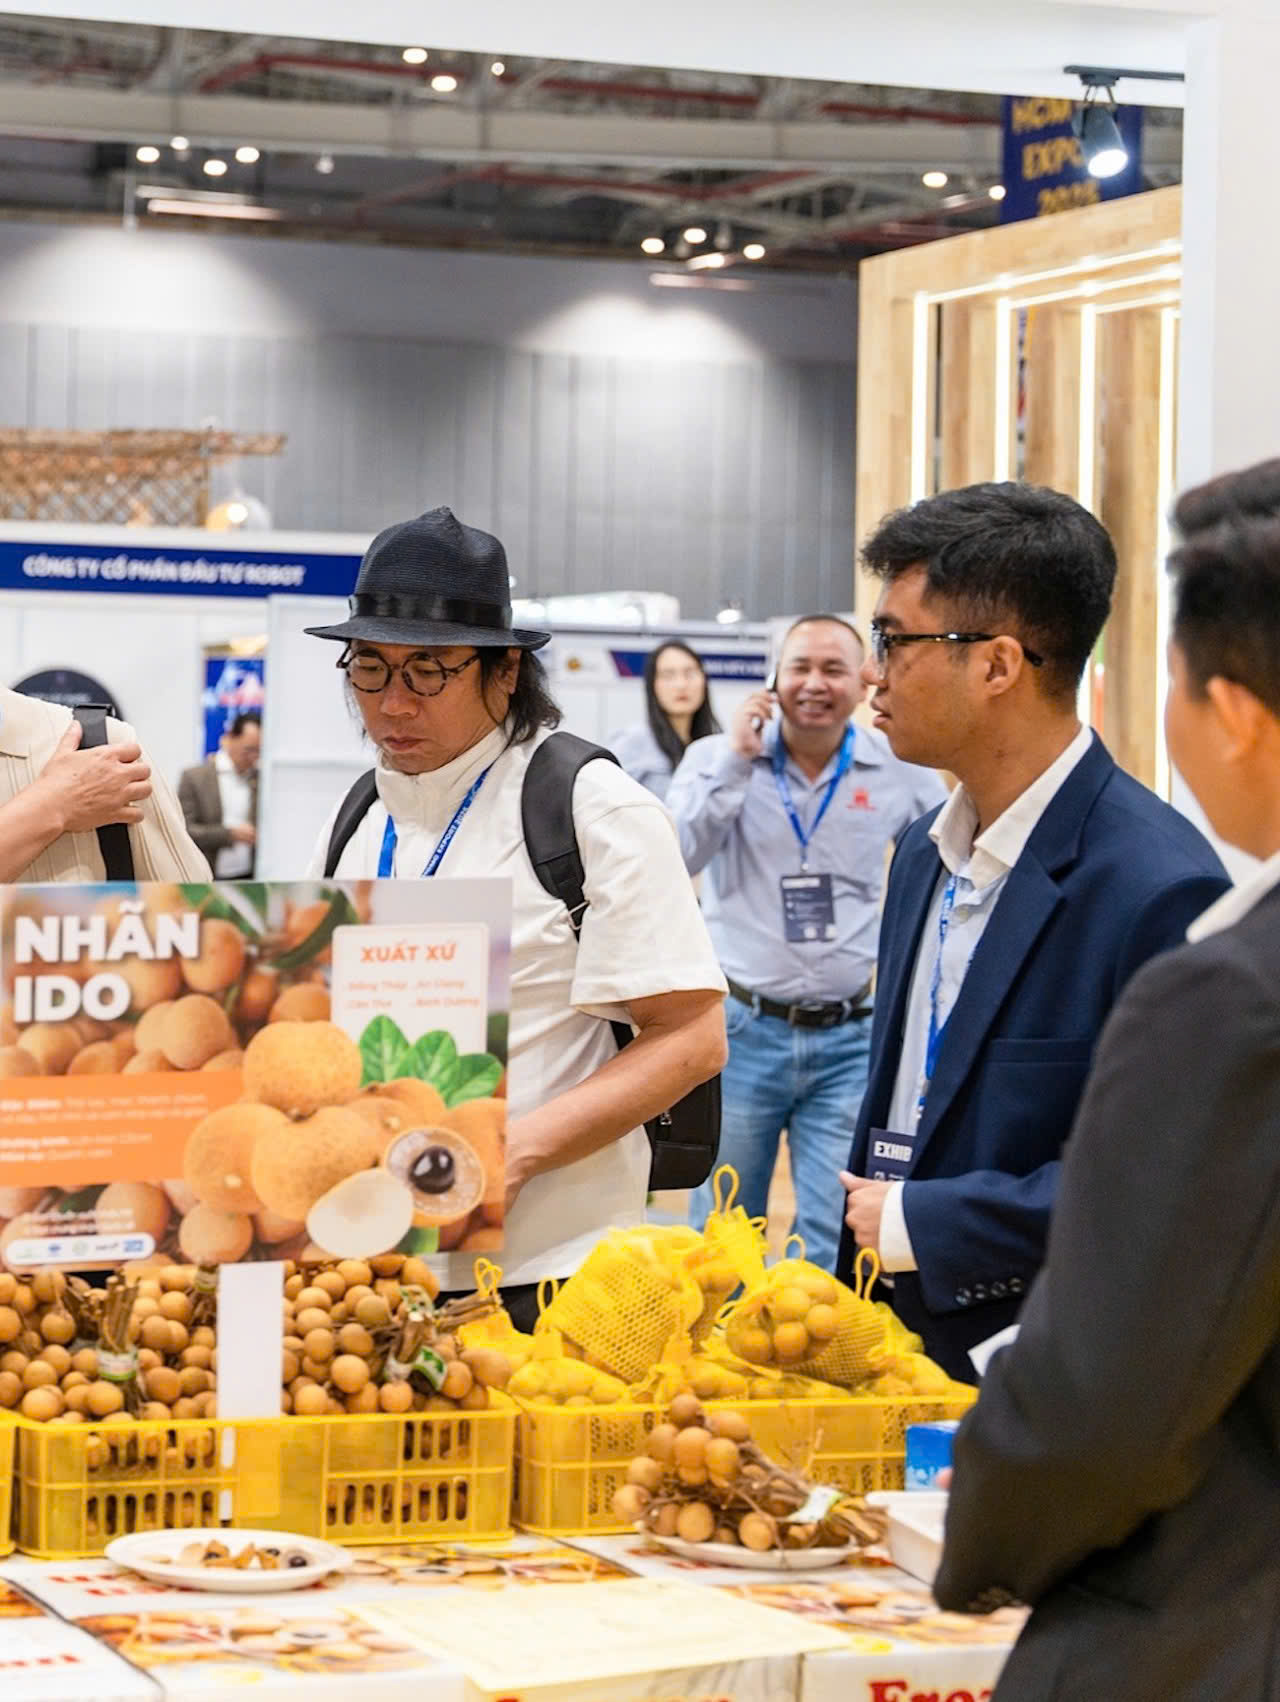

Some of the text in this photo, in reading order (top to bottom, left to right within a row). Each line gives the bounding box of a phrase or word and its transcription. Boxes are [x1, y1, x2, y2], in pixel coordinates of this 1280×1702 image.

[1012, 97, 1074, 134] HCM
[15, 899, 201, 965] NHÃN
[13, 972, 132, 1024] IDO
[874, 1140, 913, 1162] EXHIB
